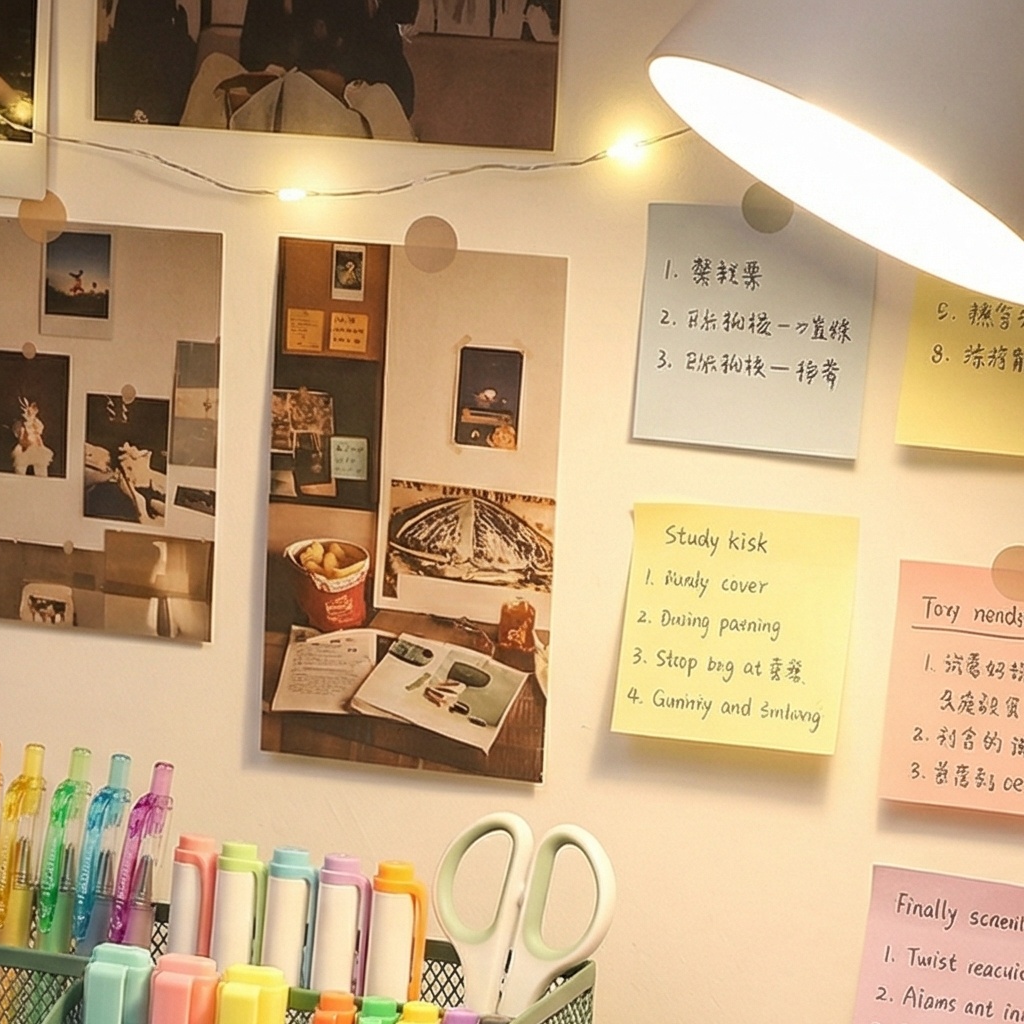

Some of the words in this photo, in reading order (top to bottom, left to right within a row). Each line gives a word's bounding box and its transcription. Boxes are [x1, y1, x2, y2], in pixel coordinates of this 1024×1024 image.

[665, 525, 719, 556] Study
[721, 578, 769, 594] cover
[721, 697, 752, 717] and
[897, 893, 957, 931] Finally
